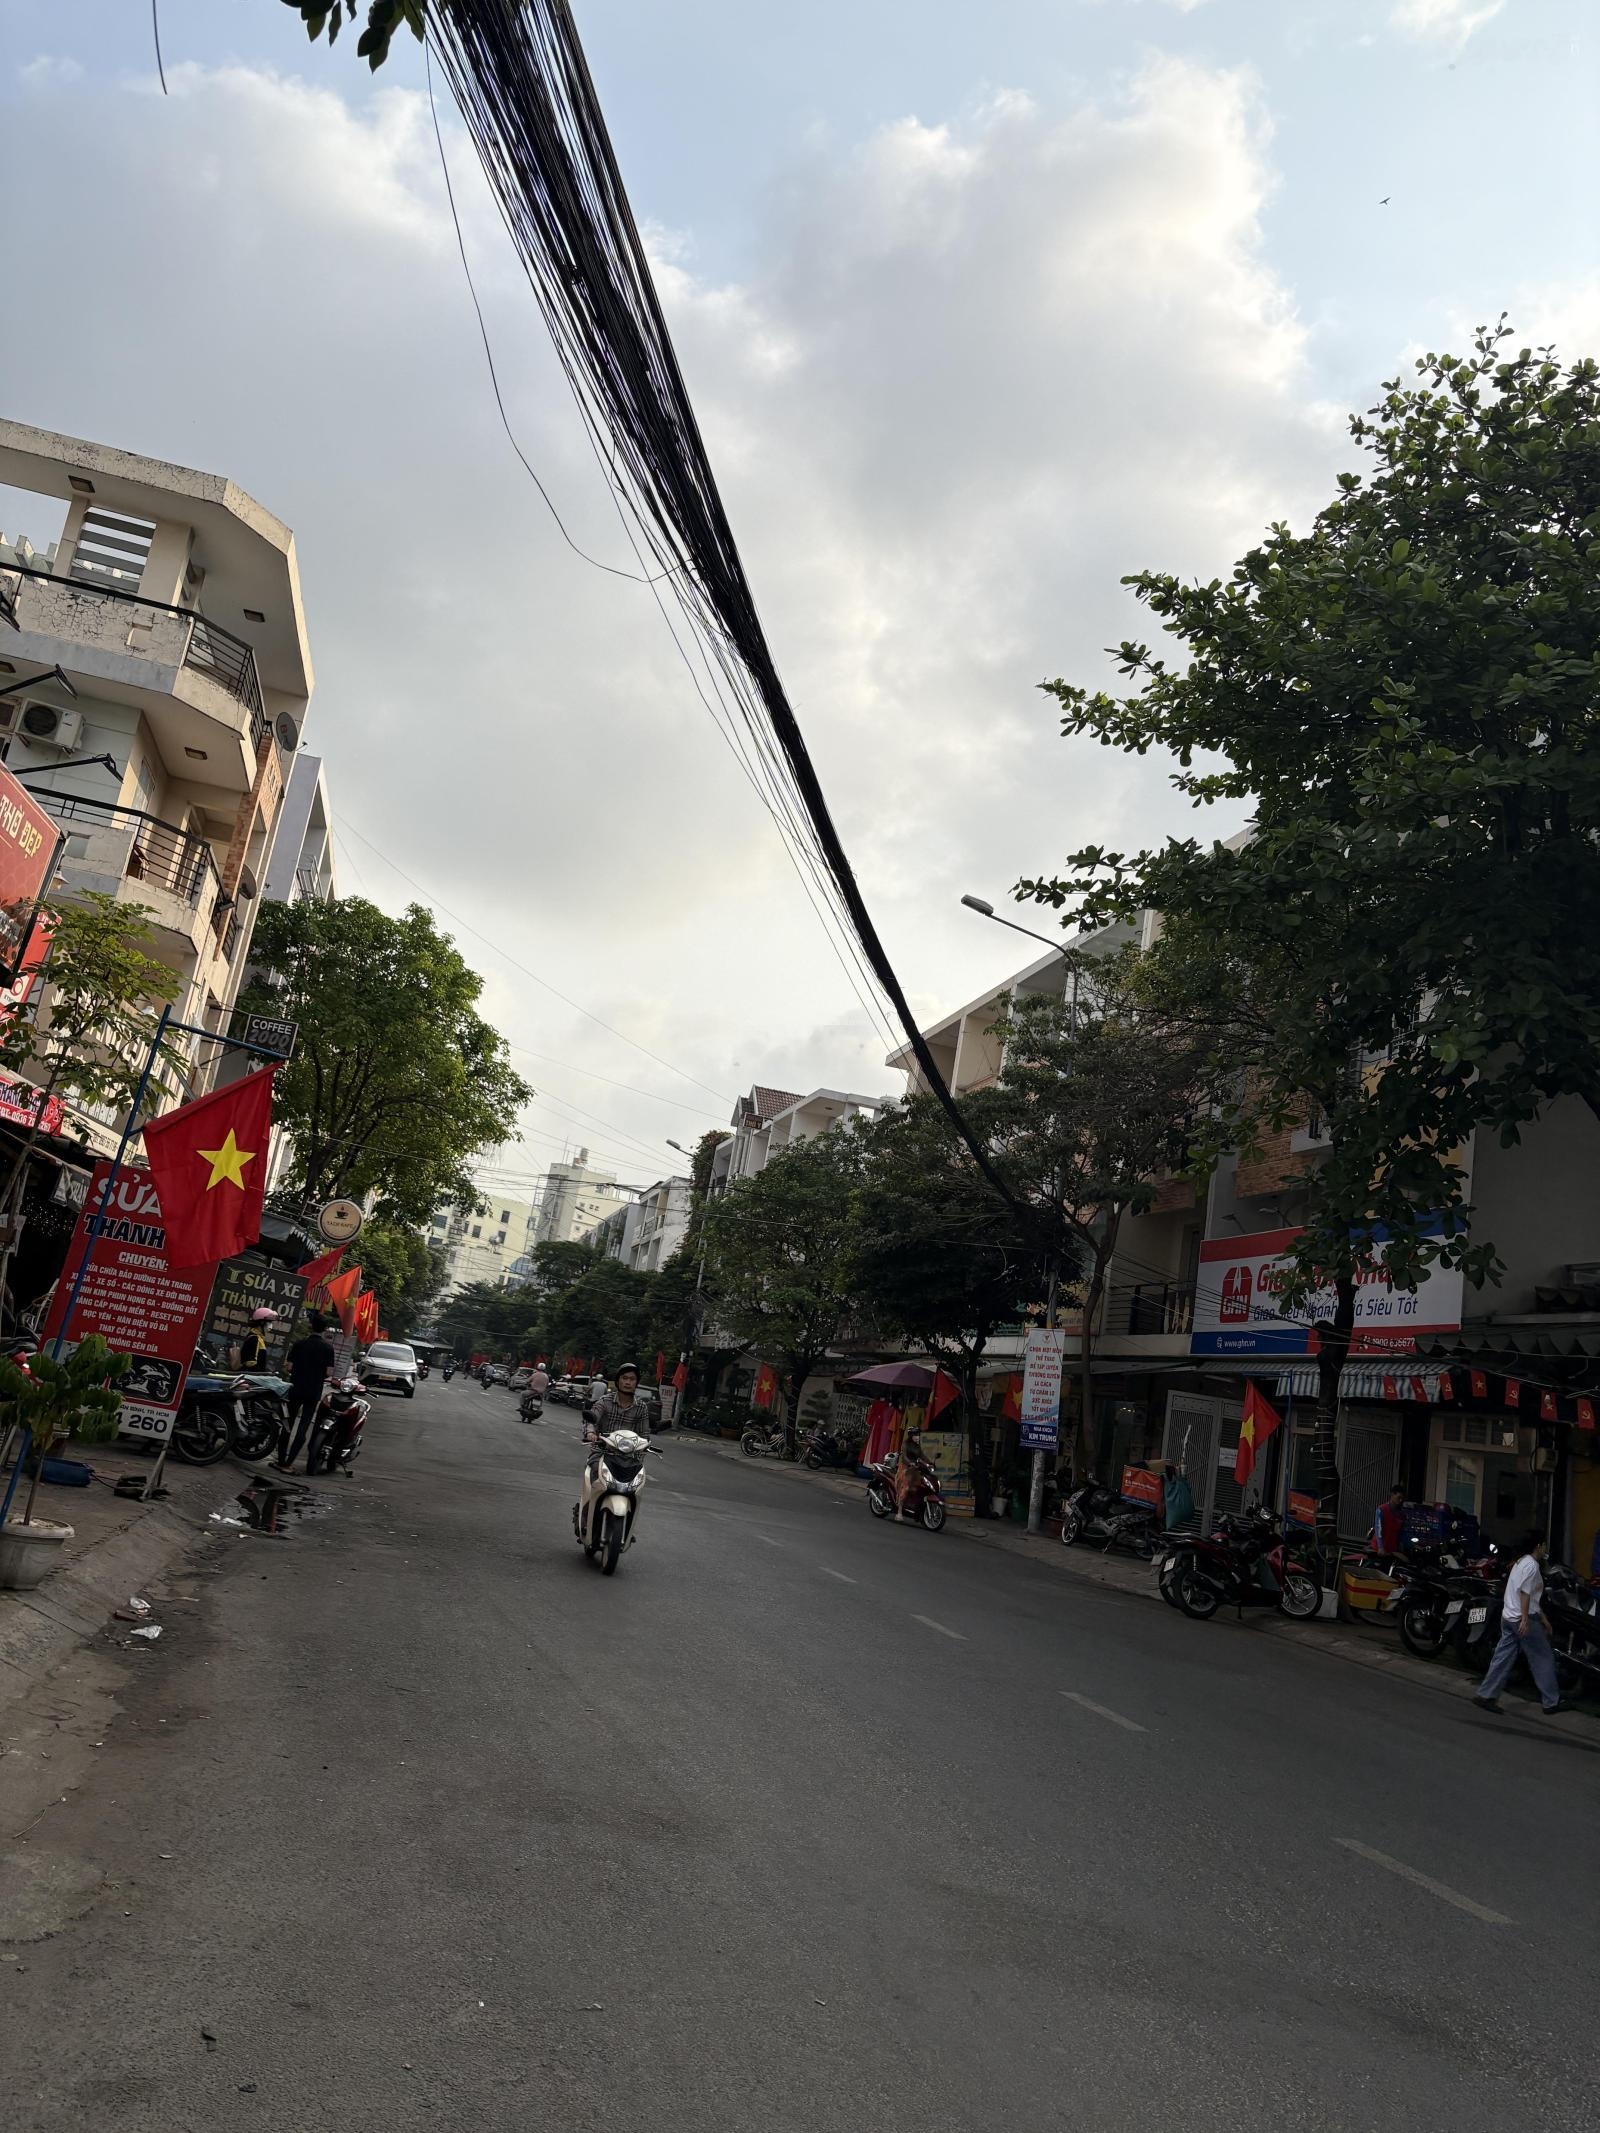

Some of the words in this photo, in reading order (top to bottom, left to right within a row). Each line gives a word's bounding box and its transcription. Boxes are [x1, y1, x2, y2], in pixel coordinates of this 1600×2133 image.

[18, 820, 43, 859] ĐẸP
[252, 1019, 292, 1035] COFFEE
[247, 1029, 290, 1048] 2000
[92, 1173, 162, 1218] SỬA
[84, 1212, 165, 1250] THÀNH
[117, 1251, 168, 1271] CHUYÊN:
[96, 1277, 105, 1286] XE
[107, 1277, 117, 1288] SỐ
[122, 1282, 134, 1292] CÁC
[155, 1288, 165, 1297] XE
[171, 1280, 192, 1292] TRANG
[242, 1271, 276, 1294] SỬA
[281, 1282, 302, 1299] XE
[93, 1288, 107, 1297] KIM
[108, 1290, 126, 1301] PHUN
[148, 1297, 156, 1306] GA
[221, 1288, 266, 1310] THÀNH
[1222, 1294, 1249, 1315] GHN
[1366, 1298, 1391, 1316] Siêu
[1397, 1293, 1418, 1315] Tốt
[151, 1310, 170, 1322] RESET
[99, 1323, 115, 1333] THAY
[137, 1330, 147, 1339] XE
[1224, 1338, 1256, 1349] www.ghn.vn
[128, 1414, 167, 1433] 260
[1028, 1432, 1039, 1441] KIM
[1039, 1433, 1057, 1443] TRUNG
